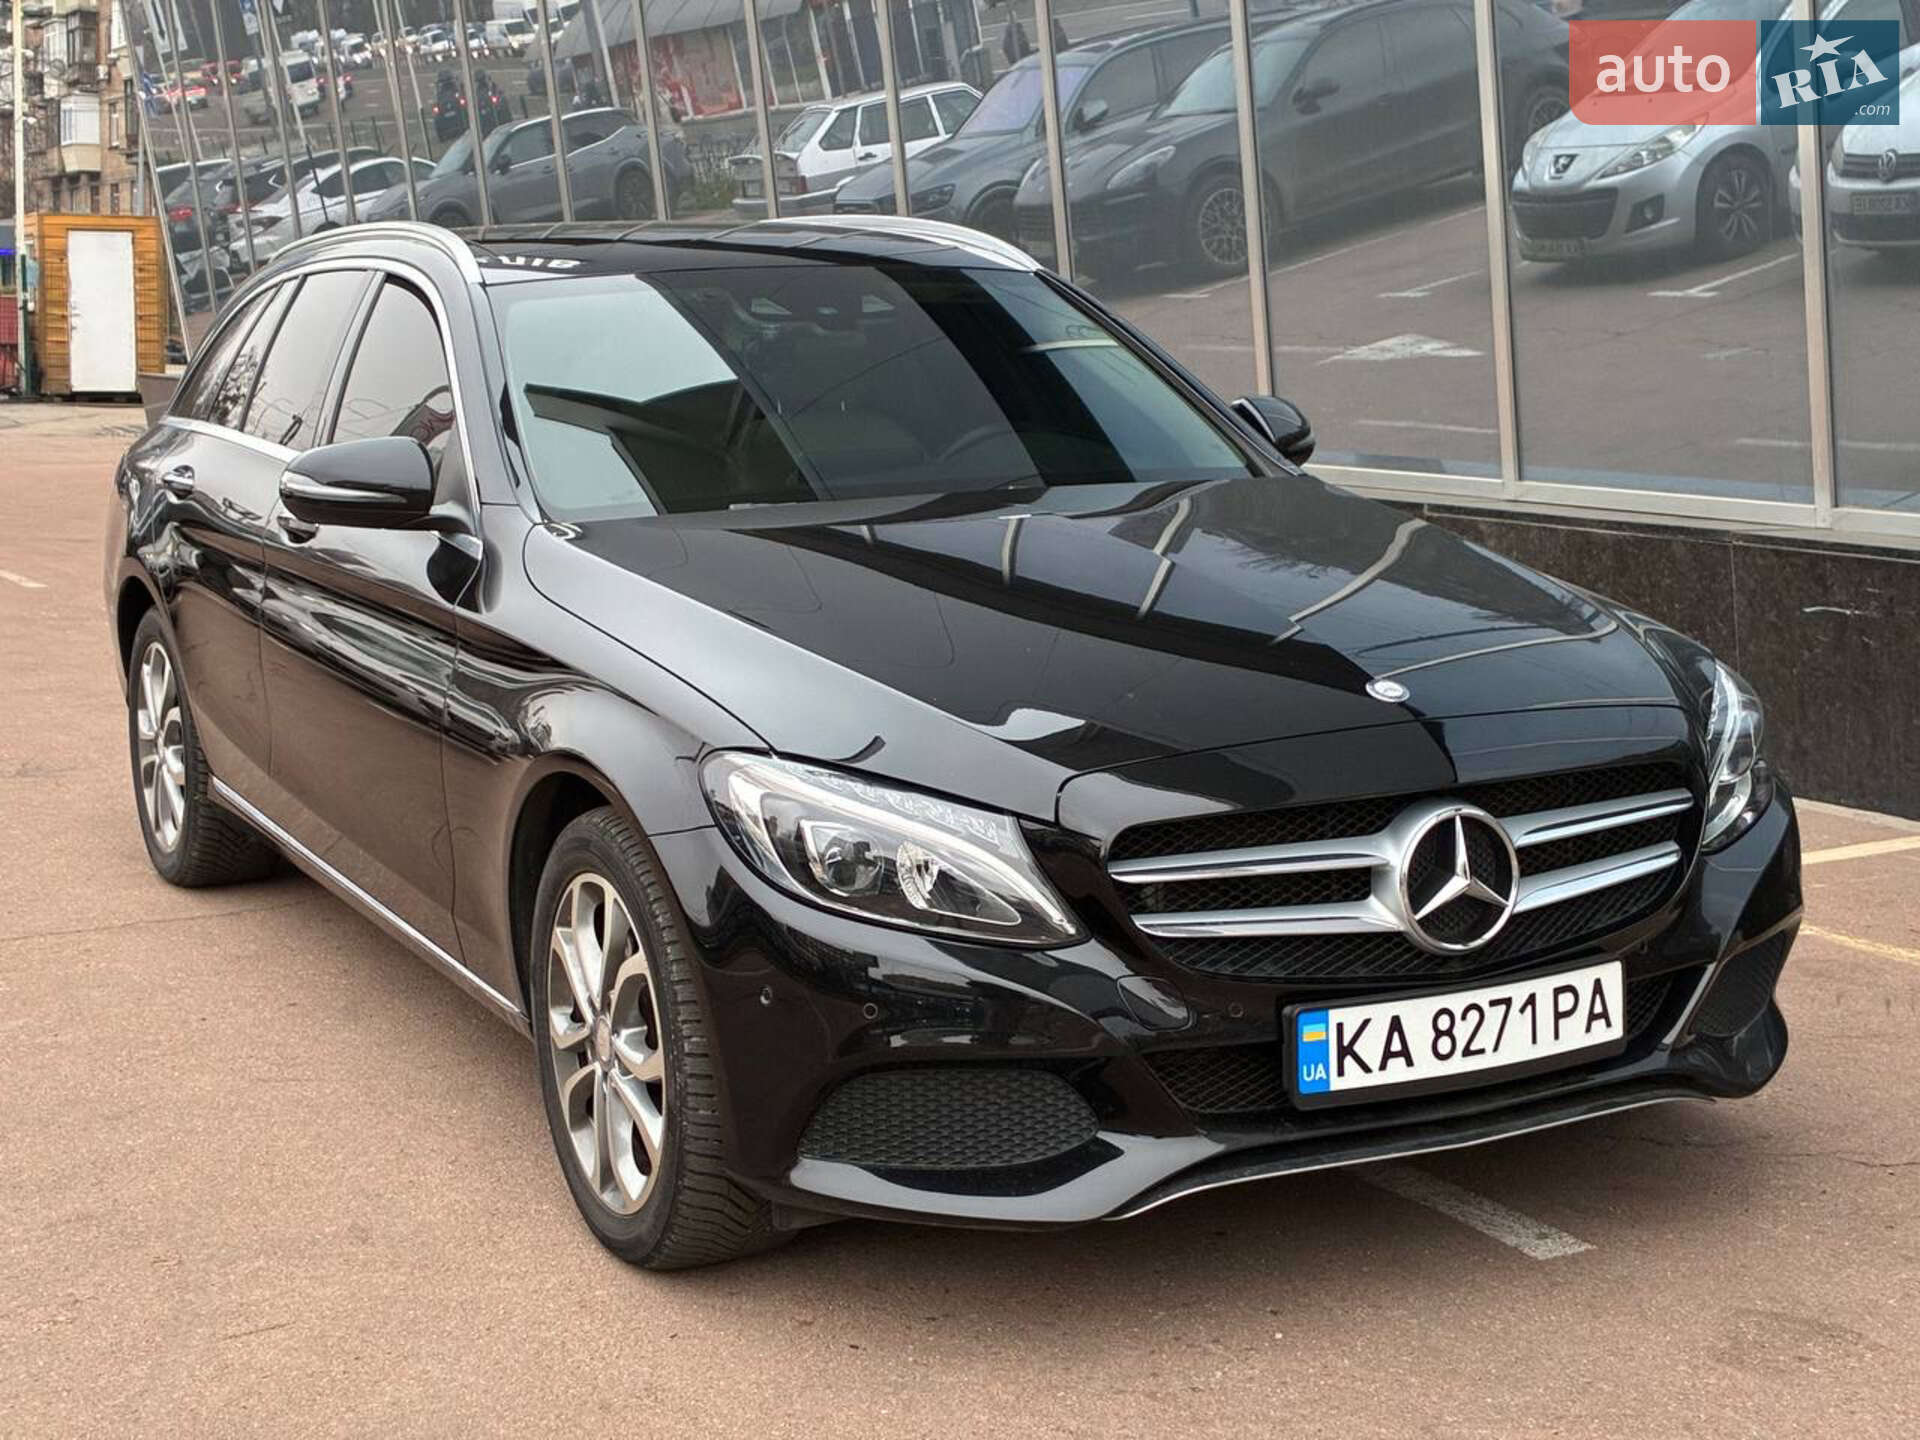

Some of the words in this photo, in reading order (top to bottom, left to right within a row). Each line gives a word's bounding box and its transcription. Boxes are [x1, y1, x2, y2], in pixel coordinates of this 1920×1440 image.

[1335, 1014, 1415, 1078] KA
[1431, 991, 1538, 1062] 8271
[1552, 976, 1613, 1042] PA
[1302, 1063, 1328, 1082] UA
